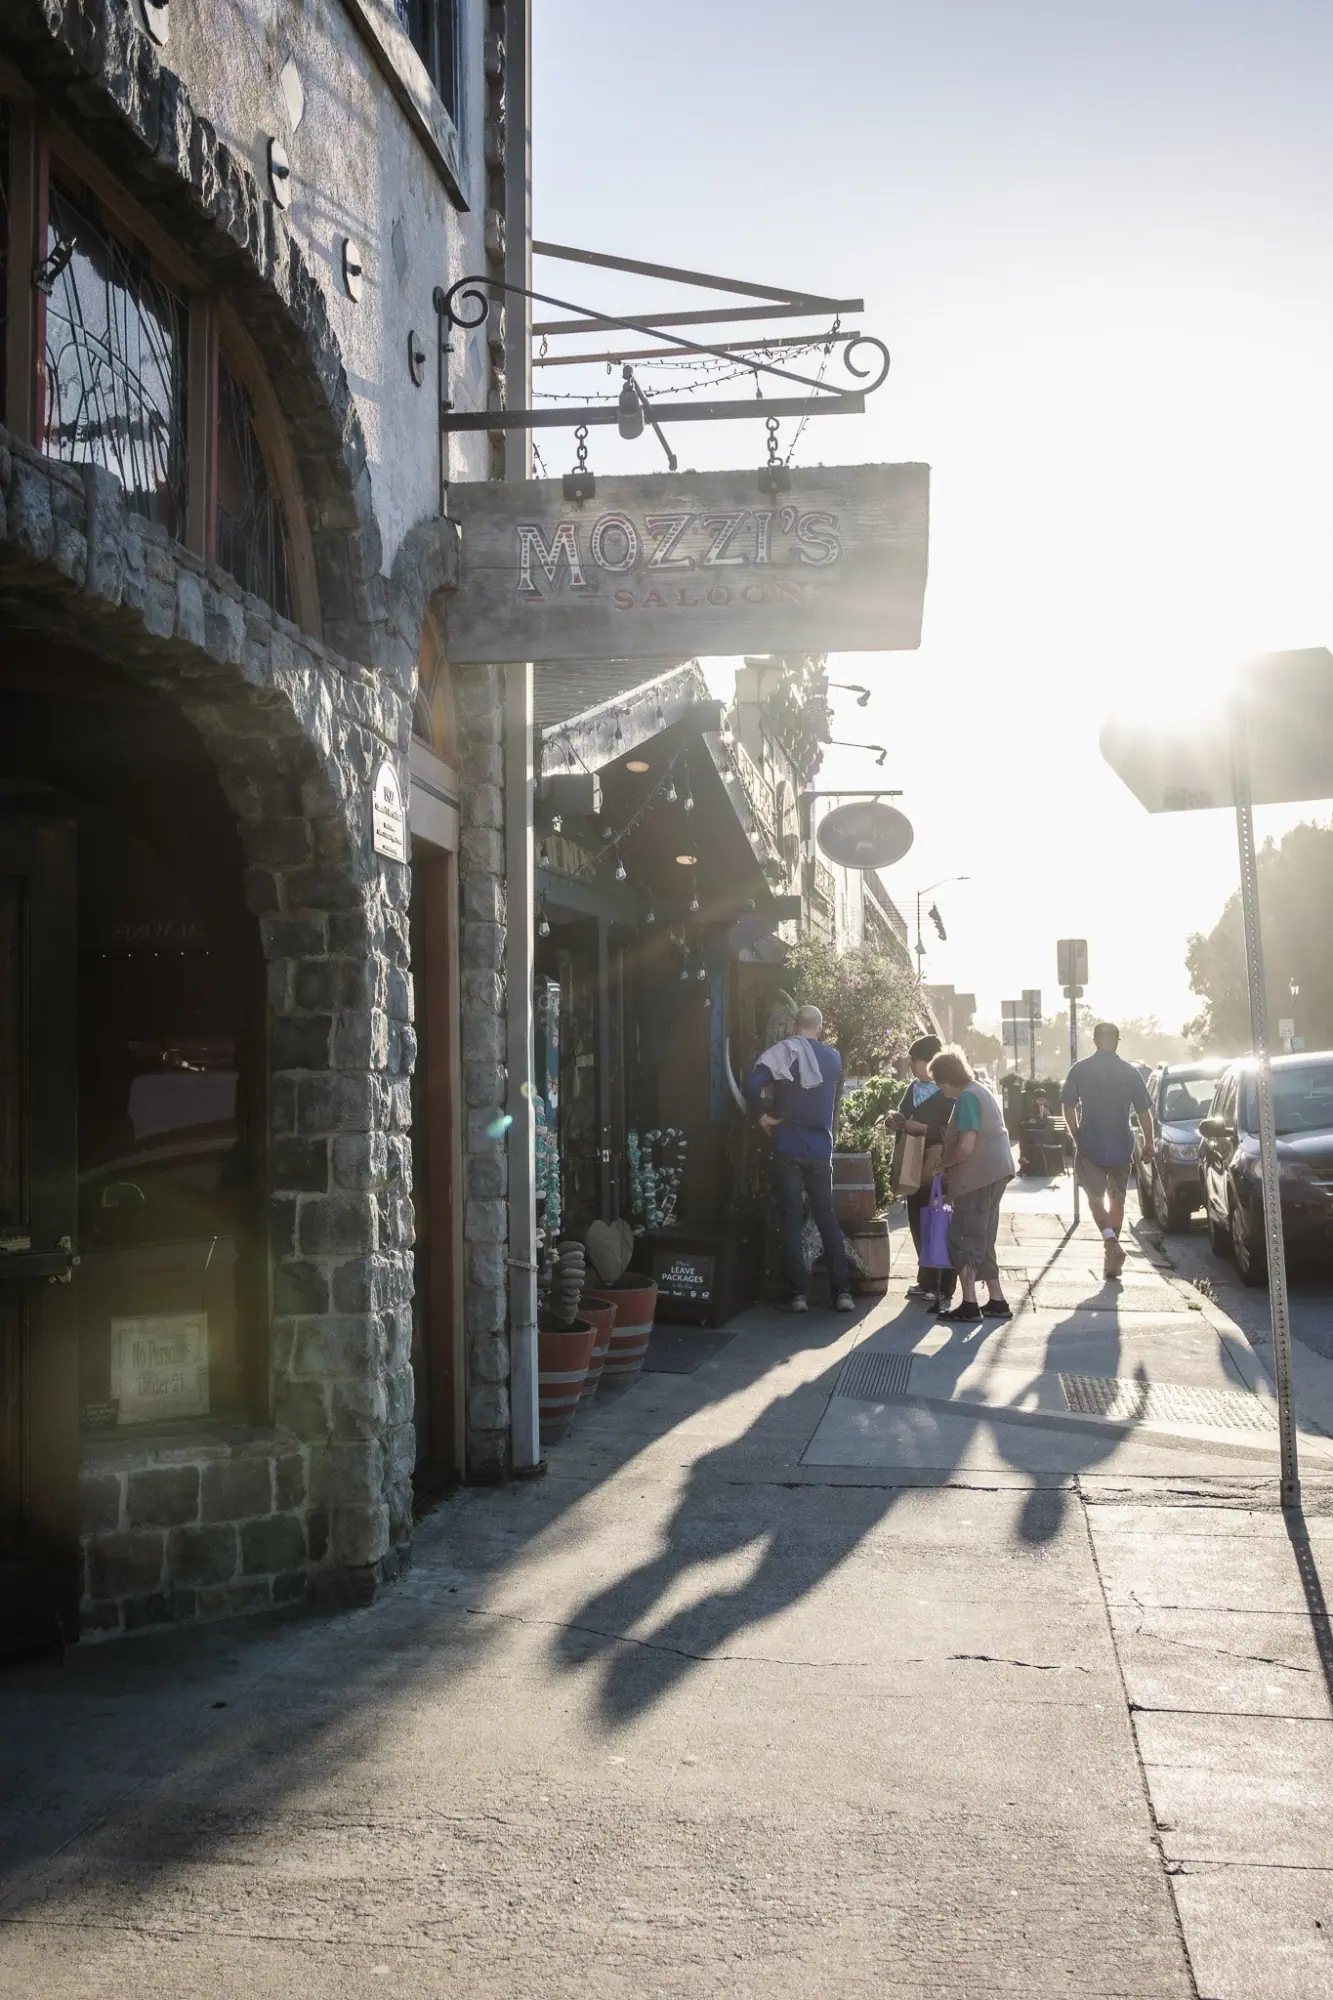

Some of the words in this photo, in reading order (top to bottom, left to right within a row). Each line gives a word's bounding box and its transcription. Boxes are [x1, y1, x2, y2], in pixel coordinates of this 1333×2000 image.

[515, 504, 844, 592] MOZZI'S
[612, 582, 811, 611] SALOON
[662, 1273, 704, 1284] PACKAGES
[671, 1266, 696, 1275] LEAVE
[132, 1341, 146, 1369] No
[172, 1372, 184, 1392] 21
